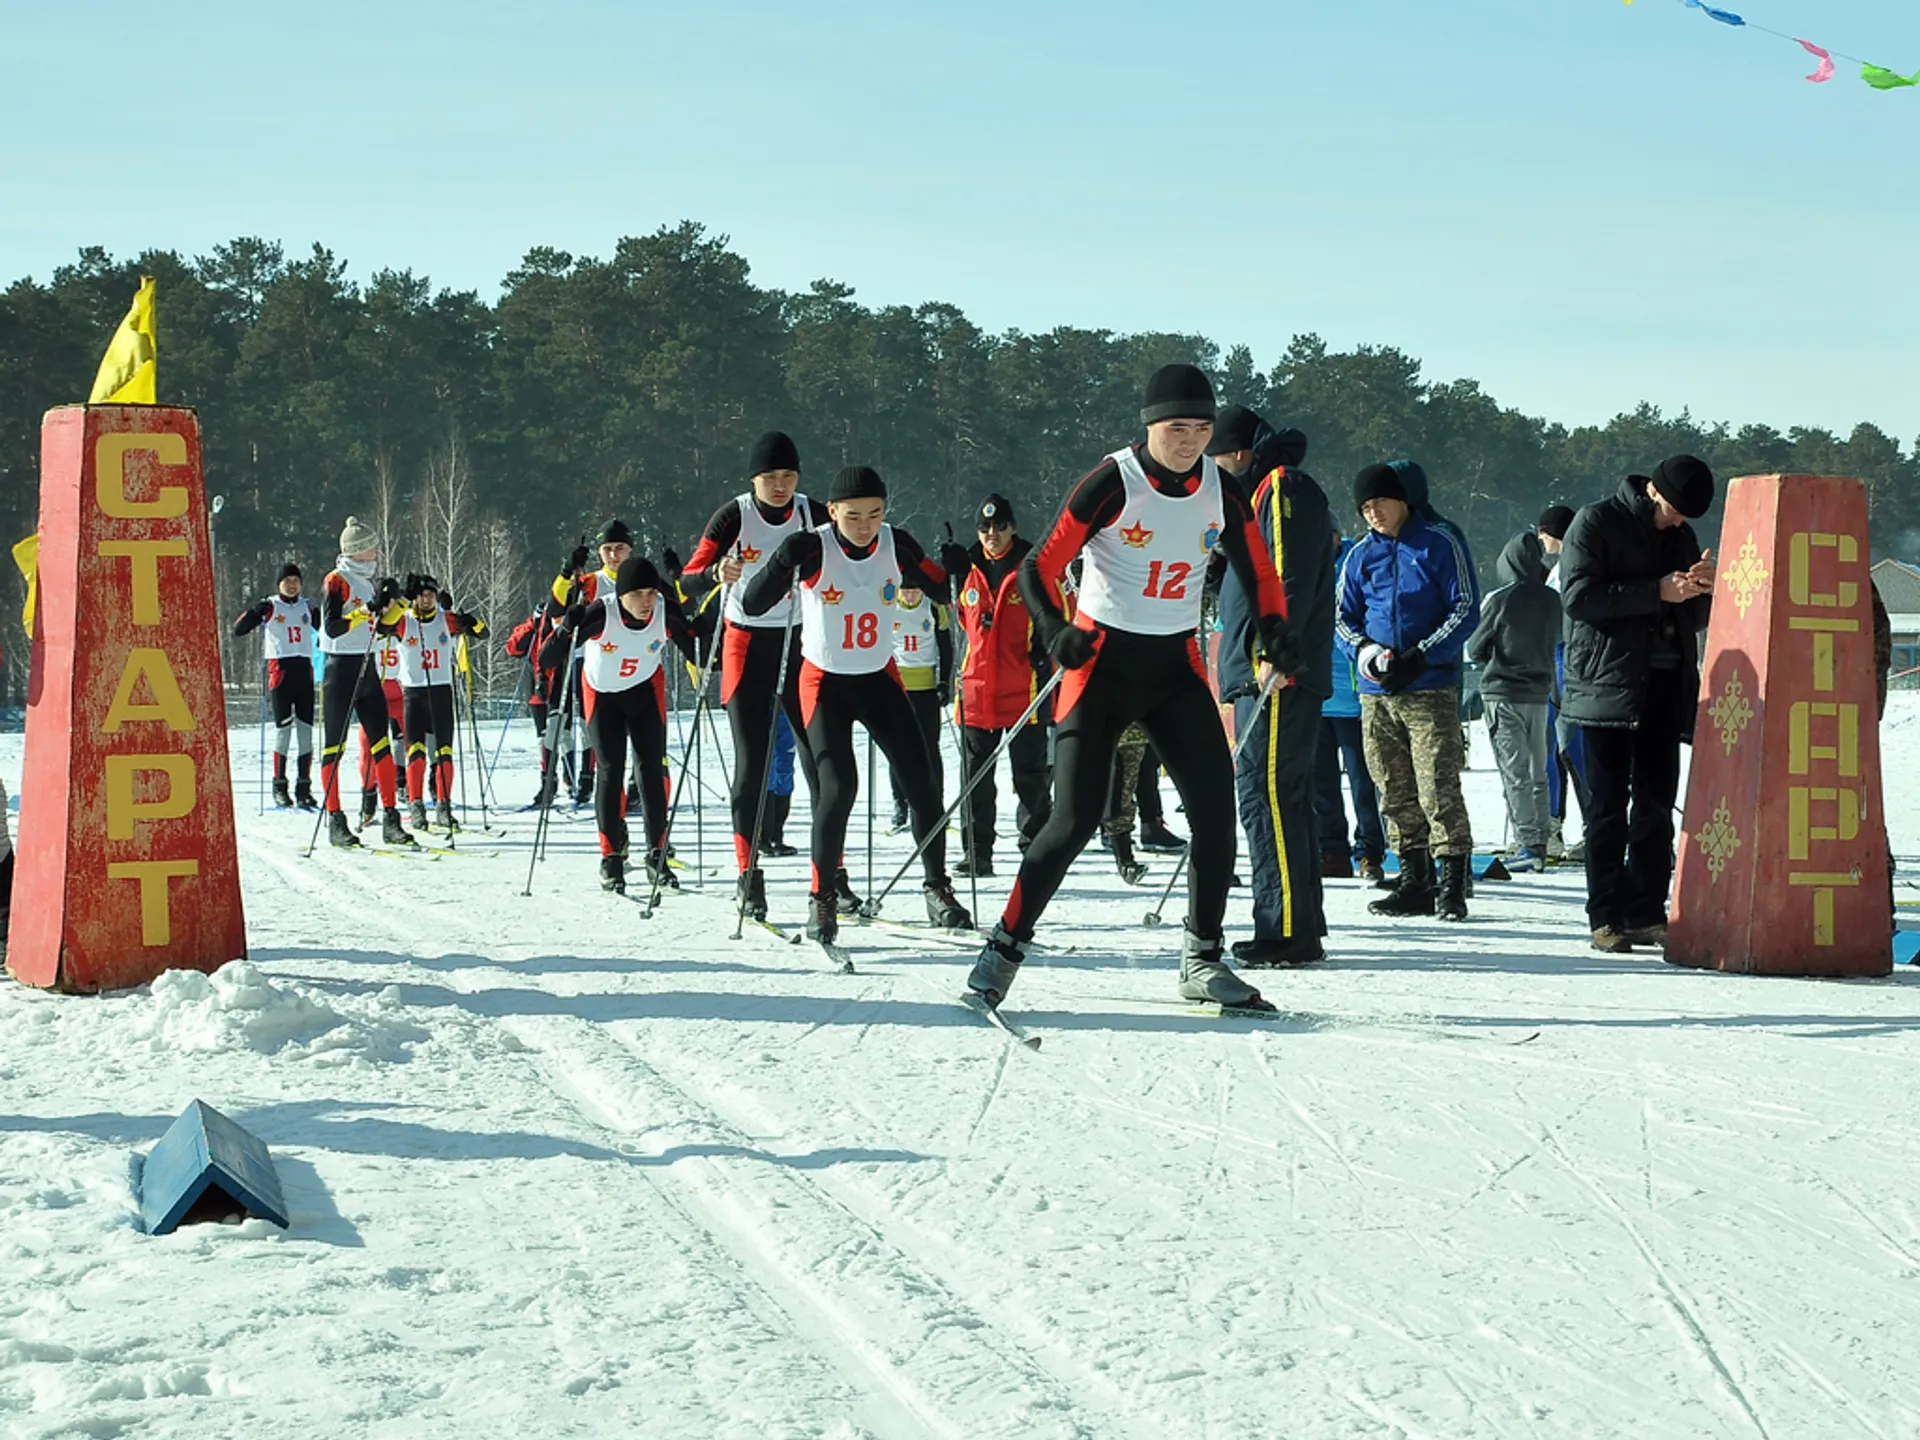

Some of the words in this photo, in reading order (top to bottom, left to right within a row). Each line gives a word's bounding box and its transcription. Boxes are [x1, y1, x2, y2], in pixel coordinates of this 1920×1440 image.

[1142, 560, 1192, 599] 12
[288, 626, 302, 644] 13
[841, 612, 879, 649] 18
[903, 635, 919, 652] 11
[380, 649, 399, 667] 15
[421, 649, 439, 670] 21
[619, 658, 639, 678] 5
[95, 432, 199, 947] СТАРТ
[1789, 532, 1860, 946] СТАРТ
